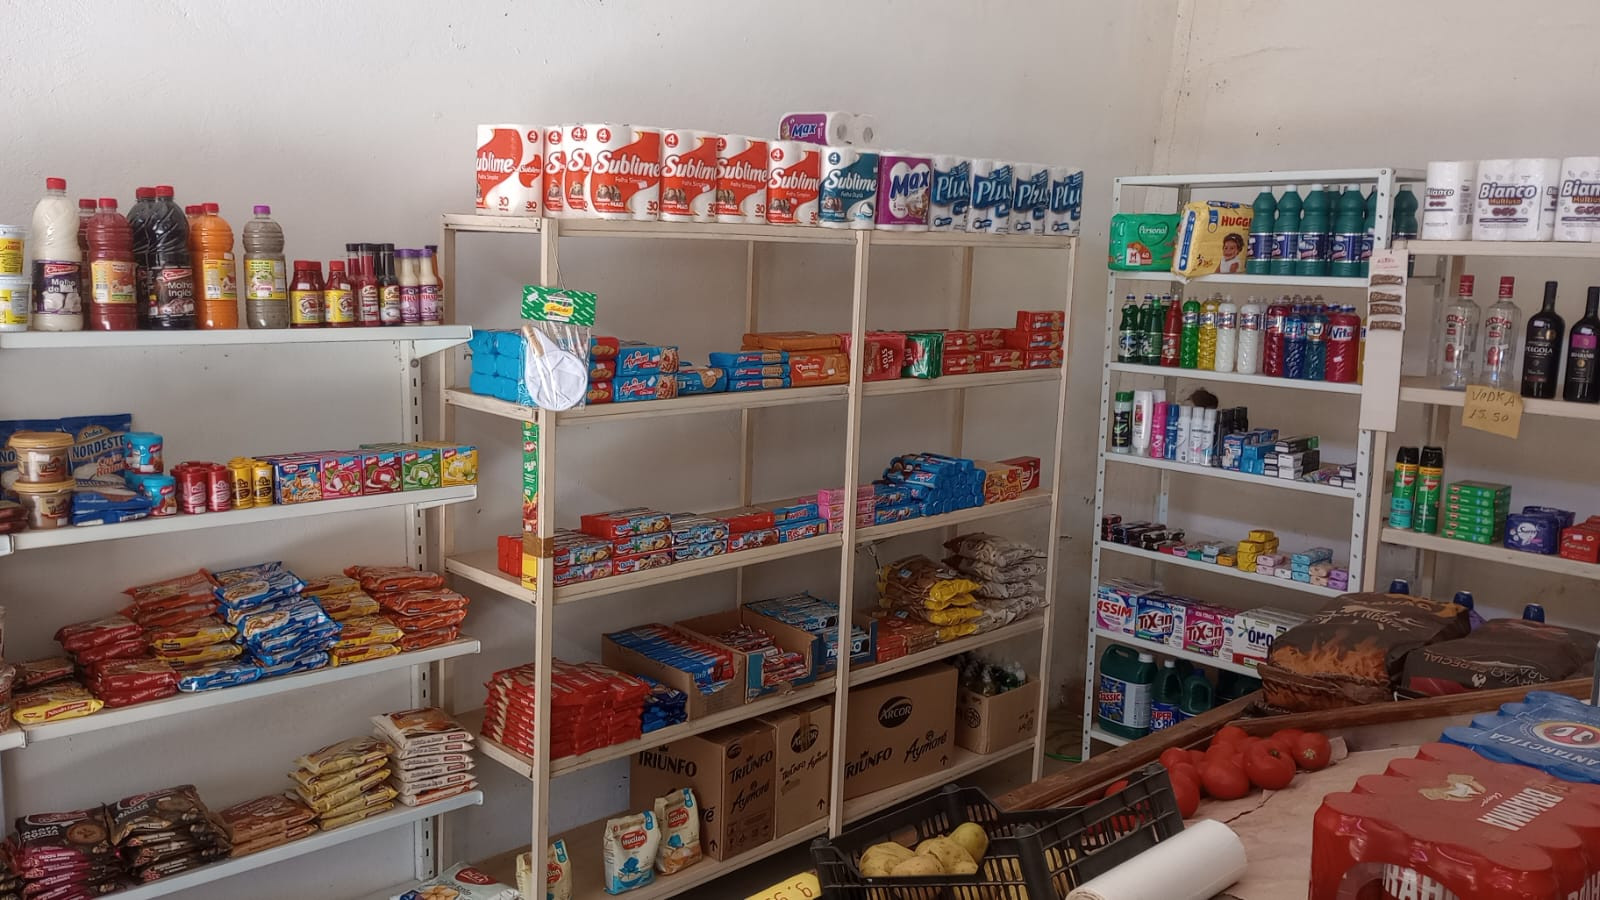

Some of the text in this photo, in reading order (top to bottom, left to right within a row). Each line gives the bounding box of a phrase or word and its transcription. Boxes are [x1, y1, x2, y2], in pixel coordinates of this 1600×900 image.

[791, 123, 818, 138] Max
[476, 151, 514, 173] ublime
[593, 150, 660, 177] Sublime
[661, 155, 717, 180] Sublim
[716, 157, 767, 182] Sublime
[768, 168, 819, 190] Sublim
[824, 169, 877, 192] Sublime
[890, 171, 930, 198] Max
[936, 177, 970, 200] Plus
[1561, 179, 1600, 197] Bian
[499, 196, 509, 207] 30
[977, 179, 1013, 204] Plus
[1018, 183, 1050, 207] Plus
[1055, 184, 1080, 208] Plu
[1479, 183, 1537, 199] Bianco
[526, 201, 537, 209] 30
[647, 201, 658, 211] 30
[755, 204, 764, 213] 30
[1139, 225, 1168, 235] Personal
[1472, 391, 1516, 407] VODKA
[1097, 600, 1133, 618] ASSIM
[879, 704, 913, 721] ARCOR
[1490, 731, 1600, 767] ANTARCTICA
[639, 752, 697, 777] TRIUNFO
[729, 750, 773, 784] TRIUNFO
[845, 747, 893, 780] TRIUNFO
[1477, 787, 1565, 832] BRAHMA
